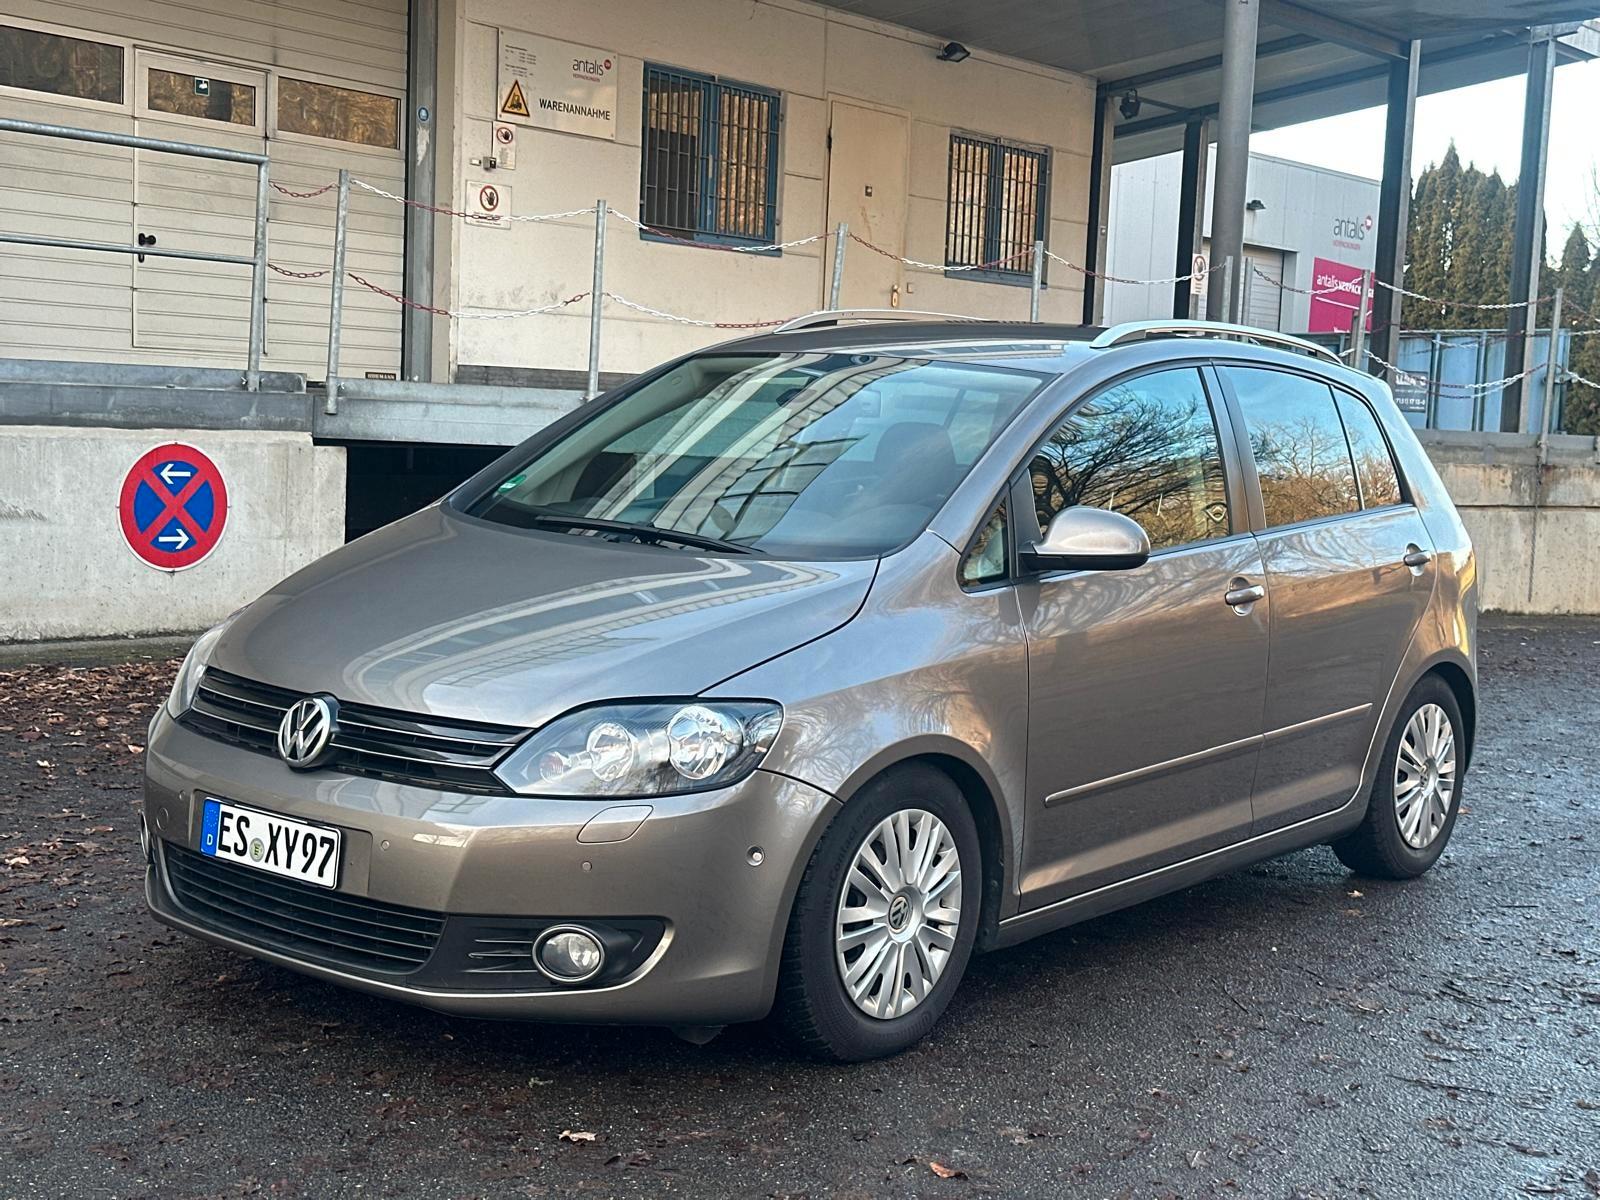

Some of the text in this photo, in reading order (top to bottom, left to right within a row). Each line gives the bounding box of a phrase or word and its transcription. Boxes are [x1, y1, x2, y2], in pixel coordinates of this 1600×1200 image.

[572, 59, 604, 76] antalis
[539, 98, 611, 121] WARENANNAHME
[1333, 216, 1365, 241] antalis
[206, 811, 336, 878] D ES XY97
